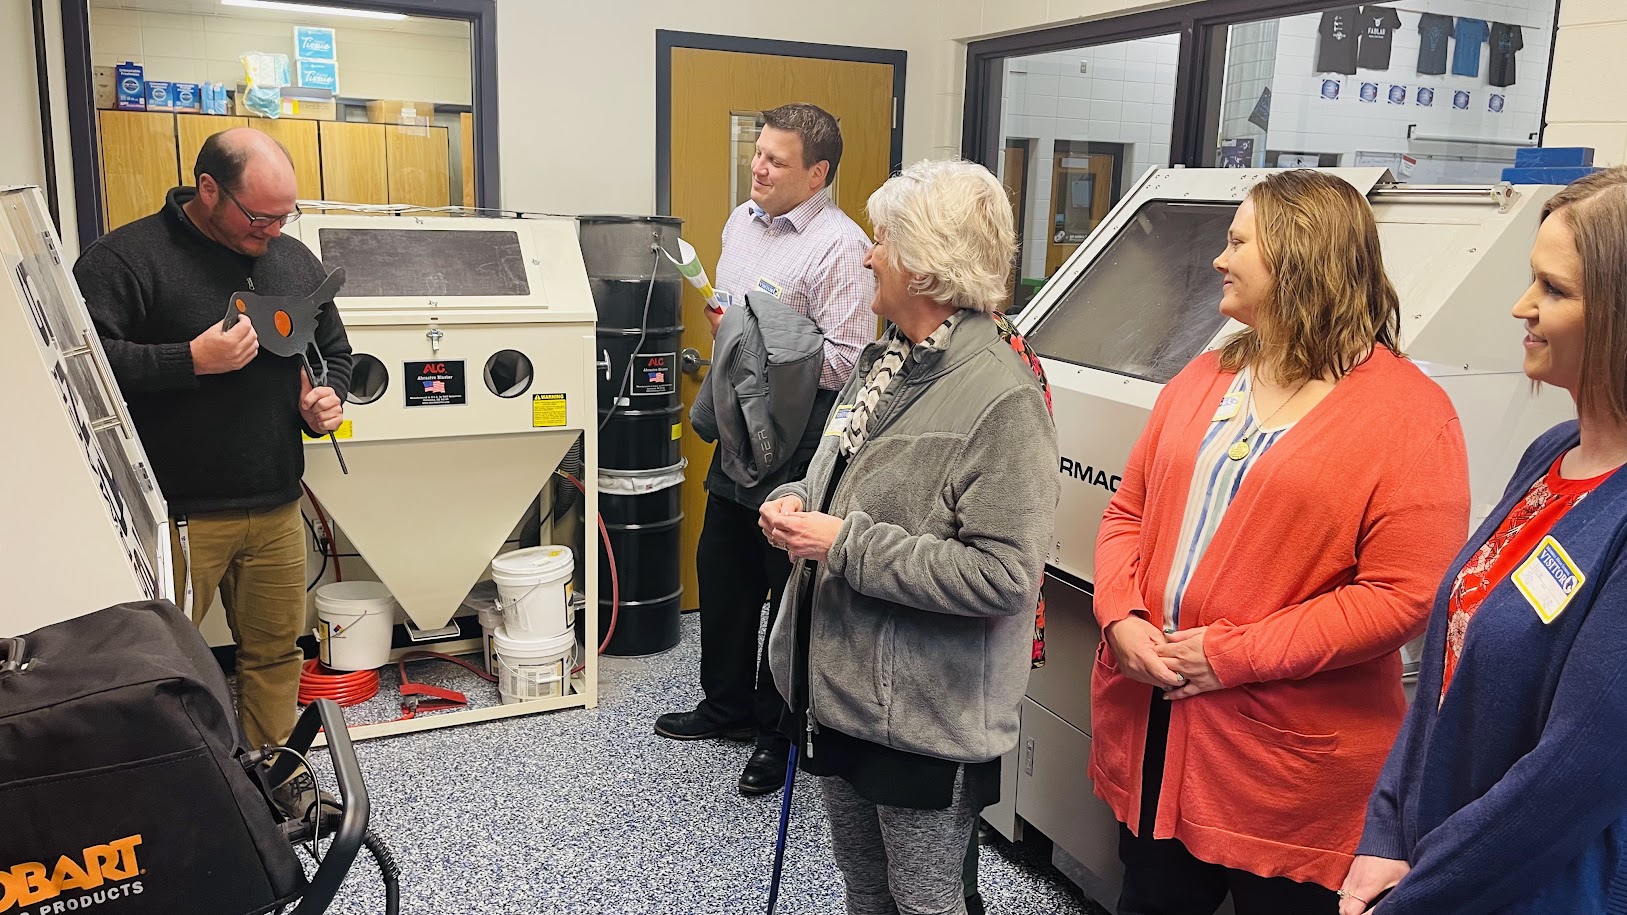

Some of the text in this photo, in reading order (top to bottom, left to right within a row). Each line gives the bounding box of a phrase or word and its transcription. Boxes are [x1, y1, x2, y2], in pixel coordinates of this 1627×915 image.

[301, 36, 331, 51] Tissue
[304, 70, 334, 84] Tissue
[423, 363, 446, 374] ALC
[648, 357, 665, 367] ALC
[758, 429, 773, 467] DER
[1540, 549, 1567, 585] VISITOR
[39, 881, 144, 915] PRODUCTS
